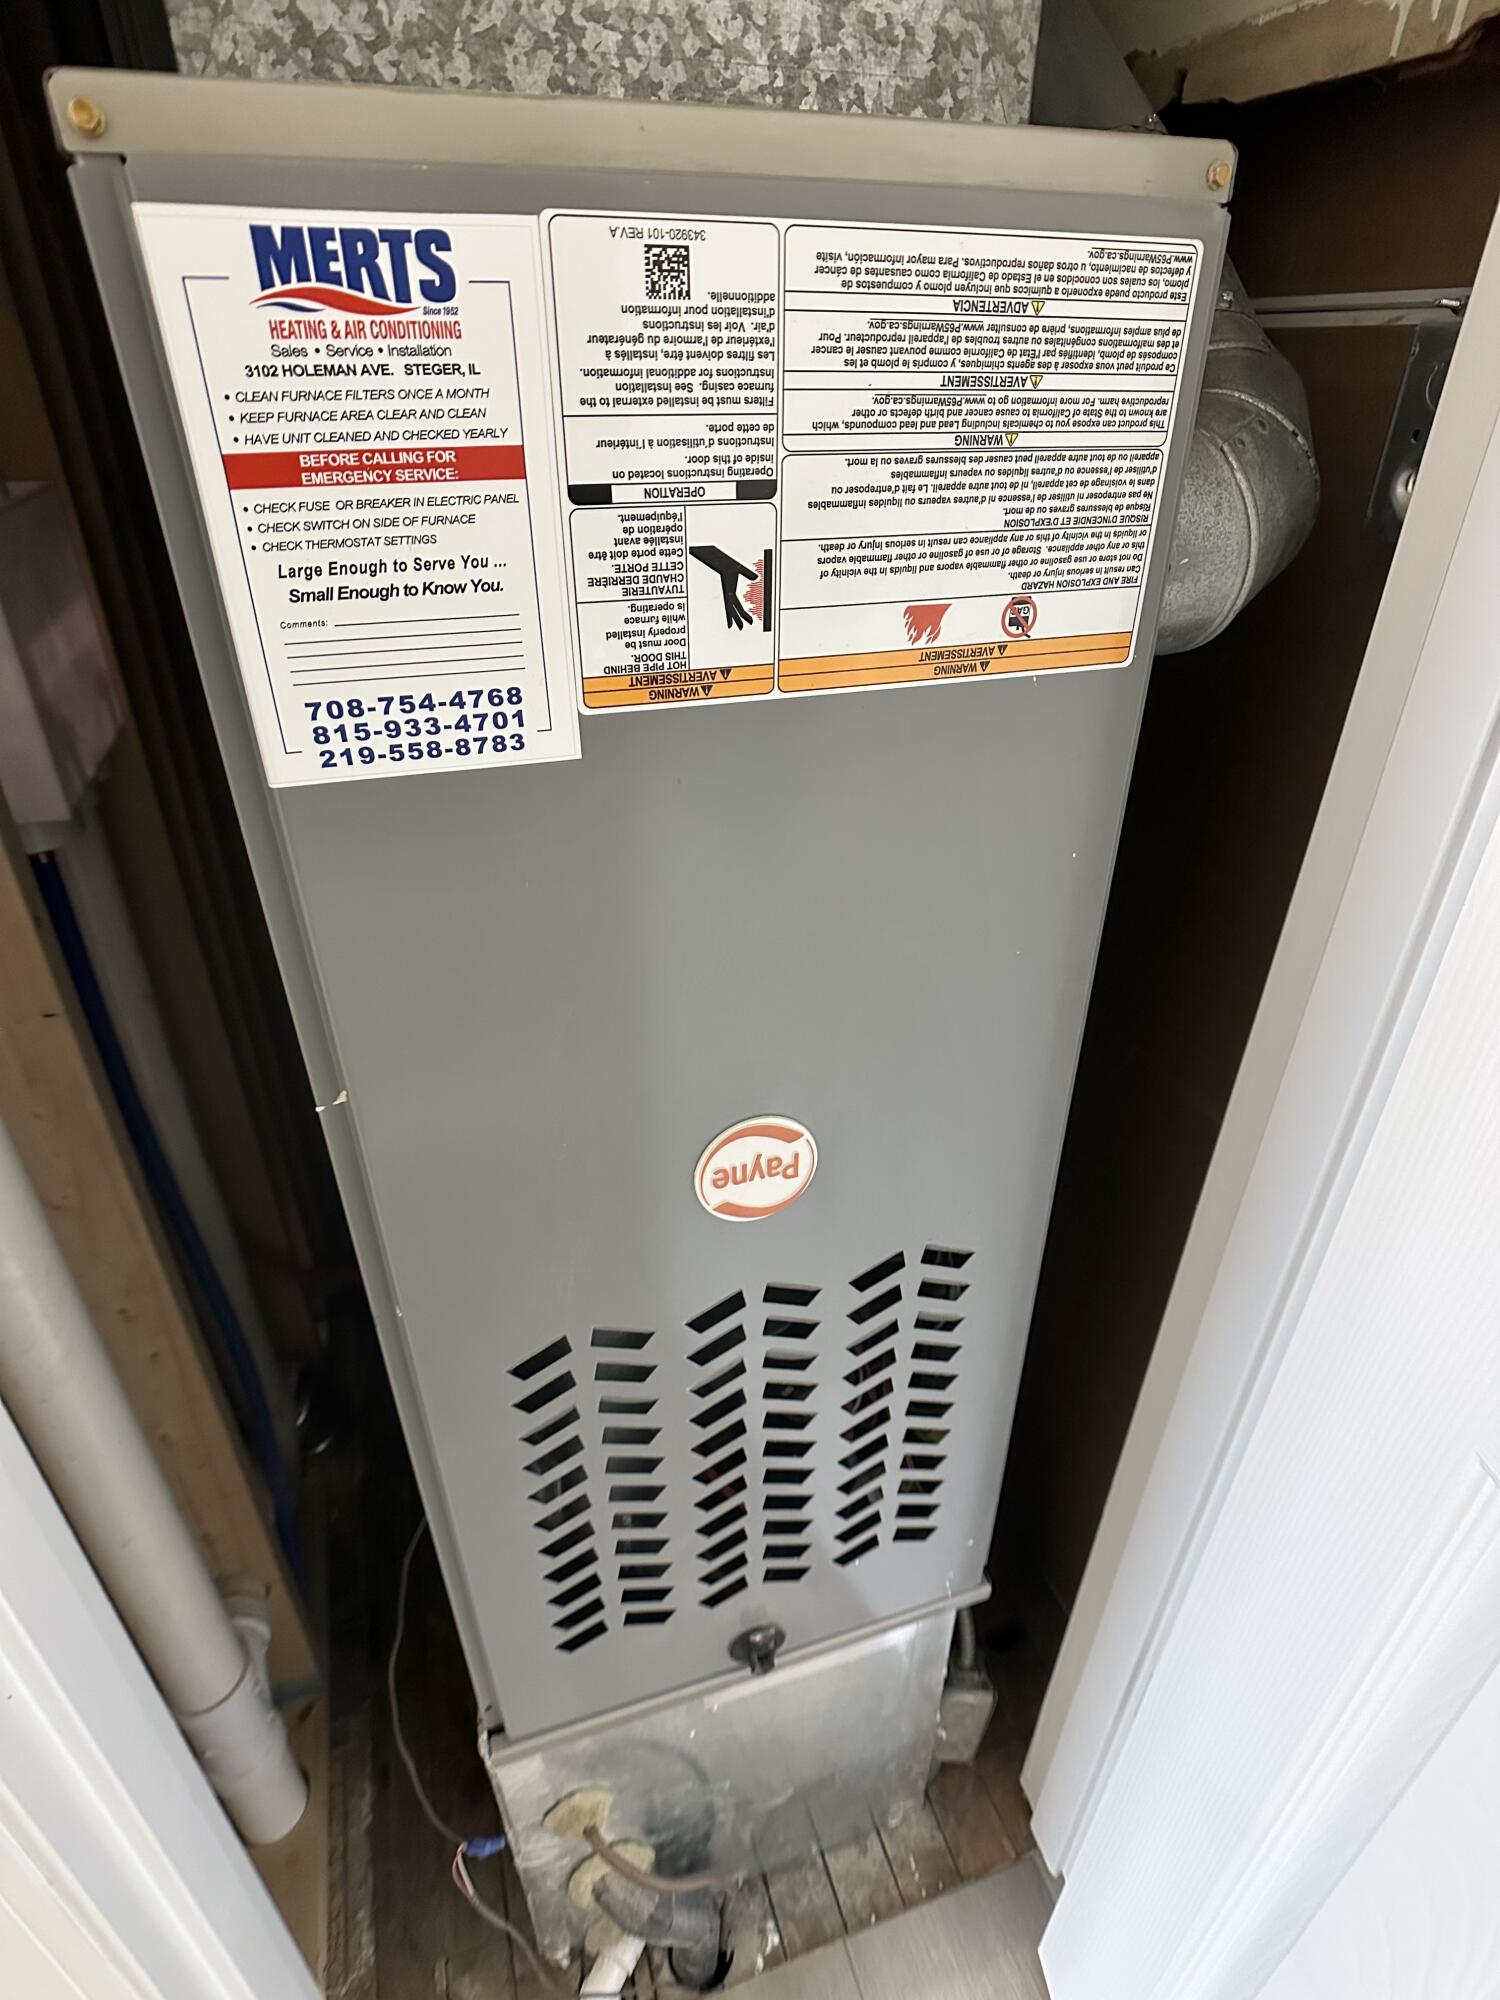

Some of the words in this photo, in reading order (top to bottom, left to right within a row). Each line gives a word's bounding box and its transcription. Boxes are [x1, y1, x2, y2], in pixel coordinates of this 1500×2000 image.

[609, 226, 644, 238] REV.A
[648, 228, 706, 241] 343920-101
[1088, 250, 1193, 264] www.P65Warnings.ca.gov.
[249, 224, 457, 304] MERTS
[423, 306, 441, 315] Since
[443, 306, 459, 316] 1952
[953, 300, 1029, 312] ADVERTENCIA
[268, 320, 328, 340] HEATING
[331, 320, 342, 340] &
[344, 320, 367, 339] AIR
[370, 320, 462, 340] CONDITIONING
[867, 319, 984, 333] www.P65Warnings.ca.gov.
[986, 324, 1027, 334] consulter
[1029, 325, 1040, 334] de
[1041, 324, 1066, 335] prière
[1068, 324, 1121, 336] informations,
[1123, 326, 1152, 337] amples
[1153, 326, 1171, 337] plus
[1172, 329, 1182, 338] de
[271, 344, 308, 358] Sales
[326, 344, 374, 357] Service
[388, 344, 452, 357] Installation
[245, 364, 279, 377] 3102
[282, 364, 357, 377] HOLEMAN
[361, 364, 394, 376] AVE.
[404, 363, 465, 377] STEGER,
[468, 363, 481, 375] IL
[699, 380, 735, 392] casing.
[940, 376, 1028, 387] AVERTISSEMENT
[615, 382, 672, 392] Installation
[674, 383, 694, 392] See
[737, 382, 774, 392] furnace
[235, 391, 278, 403] CLEAN
[282, 390, 342, 402] FURNACE
[345, 389, 395, 400] FILTERS
[398, 388, 433, 400] ONCE
[435, 388, 443, 399] A
[446, 388, 490, 399] MONTH
[998, 396, 1009, 404] go
[872, 395, 986, 407] www.P65Warnings.ca.gov.
[987, 397, 996, 406] to
[1011, 397, 1058, 407] information
[1081, 398, 1096, 406] For
[1098, 398, 1120, 407] harm.
[1121, 396, 1170, 407] reproductive
[240, 412, 274, 423] KEEP
[277, 410, 338, 423] FURNACE
[340, 410, 374, 421] AREA
[377, 409, 417, 420] CLEAR
[419, 408, 445, 419] AND
[447, 408, 486, 419] CLEAN
[245, 434, 279, 445] HAVE
[282, 432, 311, 444] UNIT
[313, 431, 371, 443] CLEANED
[373, 430, 400, 442] AND
[402, 429, 460, 440] CHECKED
[462, 428, 508, 439] YEARLY
[954, 435, 1003, 446] WARNING
[299, 453, 360, 467] BEFORE
[362, 451, 424, 465] CALLING
[426, 450, 456, 463] FOR
[685, 455, 710, 465] door.
[713, 455, 731, 465] this
[733, 454, 743, 464] of
[745, 454, 773, 464] inside
[301, 470, 392, 485] EMERGENCY
[395, 468, 459, 481] SERVICE:
[628, 470, 664, 480] located
[667, 468, 724, 479] instructions
[727, 465, 774, 478] Operating
[644, 486, 706, 499] OPERATION
[254, 502, 296, 514] CHECK
[299, 500, 330, 512] FUSE
[336, 500, 354, 510] OR
[356, 498, 411, 509] BREAKER
[413, 497, 424, 507] IN
[427, 495, 481, 506] ELECTRIC
[484, 494, 519, 504] PANEL
[1049, 504, 1075, 513] graves
[1077, 504, 1113, 513] blessures
[1114, 504, 1124, 512] de
[1126, 502, 1151, 512] Risque
[1003, 507, 1024, 516] mort.
[1025, 507, 1035, 515] de
[258, 521, 301, 533] CHECK
[303, 520, 350, 531] SWITCH
[352, 518, 370, 529] ON
[373, 517, 400, 528] SIDE
[402, 516, 419, 527] OF
[421, 514, 476, 526] FURNACE
[1004, 517, 1059, 528] D'EXPLOSION
[1060, 517, 1071, 526] ET
[1073, 515, 1118, 525] D'INCENDIE
[1119, 514, 1149, 523] RISQUE
[262, 540, 303, 552] CHECK
[305, 537, 382, 550] THERMOSTAT
[384, 534, 437, 546] SETTINGS
[278, 565, 322, 581] Large
[329, 560, 387, 577] Enough
[393, 559, 408, 572] to
[413, 558, 455, 571] Serve
[461, 555, 488, 569] You
[1043, 568, 1065, 578] injury
[1066, 568, 1094, 576] serious
[1096, 567, 1102, 575] in
[1104, 566, 1125, 575] result
[1126, 565, 1141, 573] Can
[1008, 571, 1032, 580] death.
[1120, 576, 1138, 584] FIRE
[1021, 580, 1054, 590] HAZARD
[1056, 578, 1101, 588] EXPLOSION
[1102, 577, 1120, 585] AND
[289, 587, 334, 603] Small
[338, 583, 400, 601] Enough
[403, 584, 419, 596] to
[422, 581, 468, 596] Know
[470, 578, 503, 593] You.
[628, 602, 674, 614] operating.
[677, 602, 685, 611] is
[624, 616, 659, 624] furnace
[662, 614, 685, 624] while
[280, 620, 328, 629] Comments:
[606, 630, 645, 641] installed
[648, 626, 686, 637] properly
[625, 641, 636, 650] be
[638, 640, 662, 649] must
[664, 638, 686, 647] Door
[631, 653, 662, 663] DOOR.
[665, 651, 686, 661] THIS
[918, 646, 996, 662] AVERTISSEMENT
[603, 664, 640, 675] BEHIND
[643, 662, 664, 672] PIPE
[667, 661, 687, 670] HOT
[934, 663, 977, 676] WARNING
[628, 670, 717, 687] AVERTISSEMENT
[648, 687, 699, 700] WARNING
[304, 687, 522, 720] 708-754-4768
[313, 710, 524, 744] 815-933-4701
[319, 733, 525, 768] 219-558-8783
[712, 1153, 800, 1189] Payne
